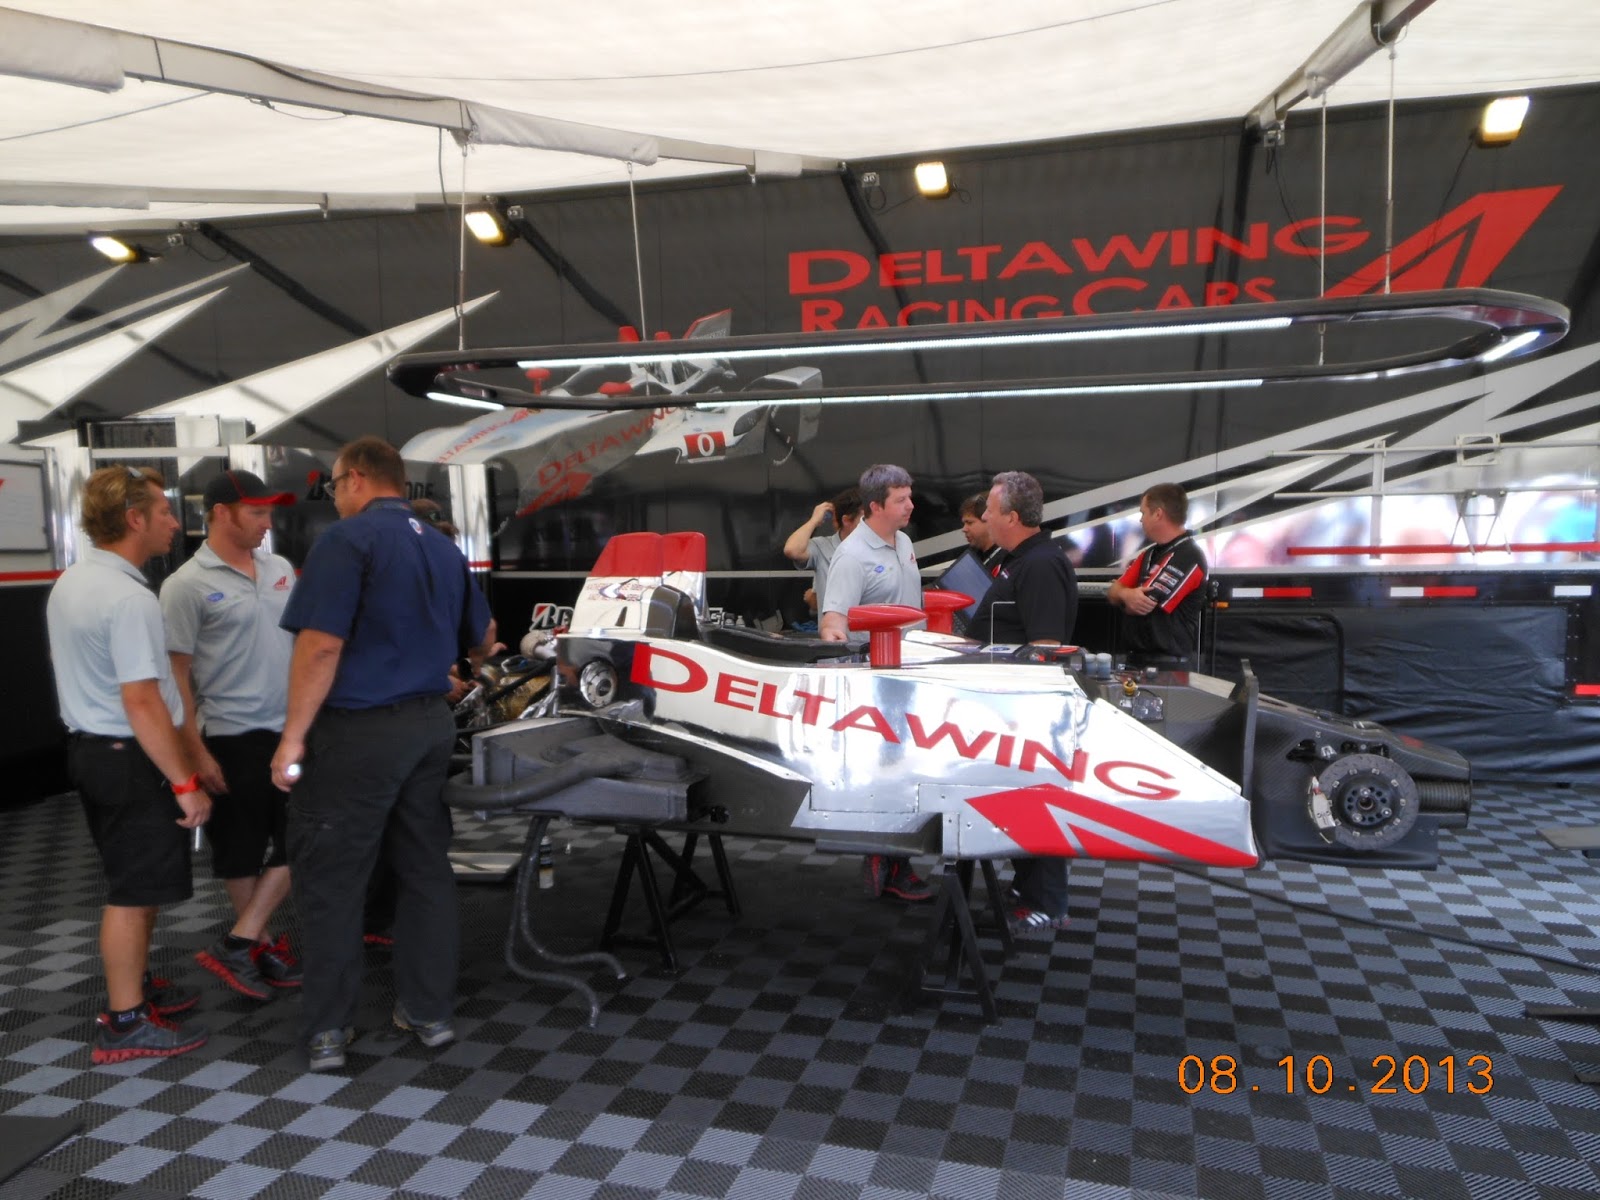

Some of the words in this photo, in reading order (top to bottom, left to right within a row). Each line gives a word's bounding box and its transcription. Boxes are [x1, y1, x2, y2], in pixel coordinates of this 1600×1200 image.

[789, 216, 1370, 294] DELTAWING
[801, 295, 1064, 333] RACING
[1072, 277, 1276, 316] CARS
[697, 433, 715, 457] 0
[629, 642, 1180, 800] DELTAWING
